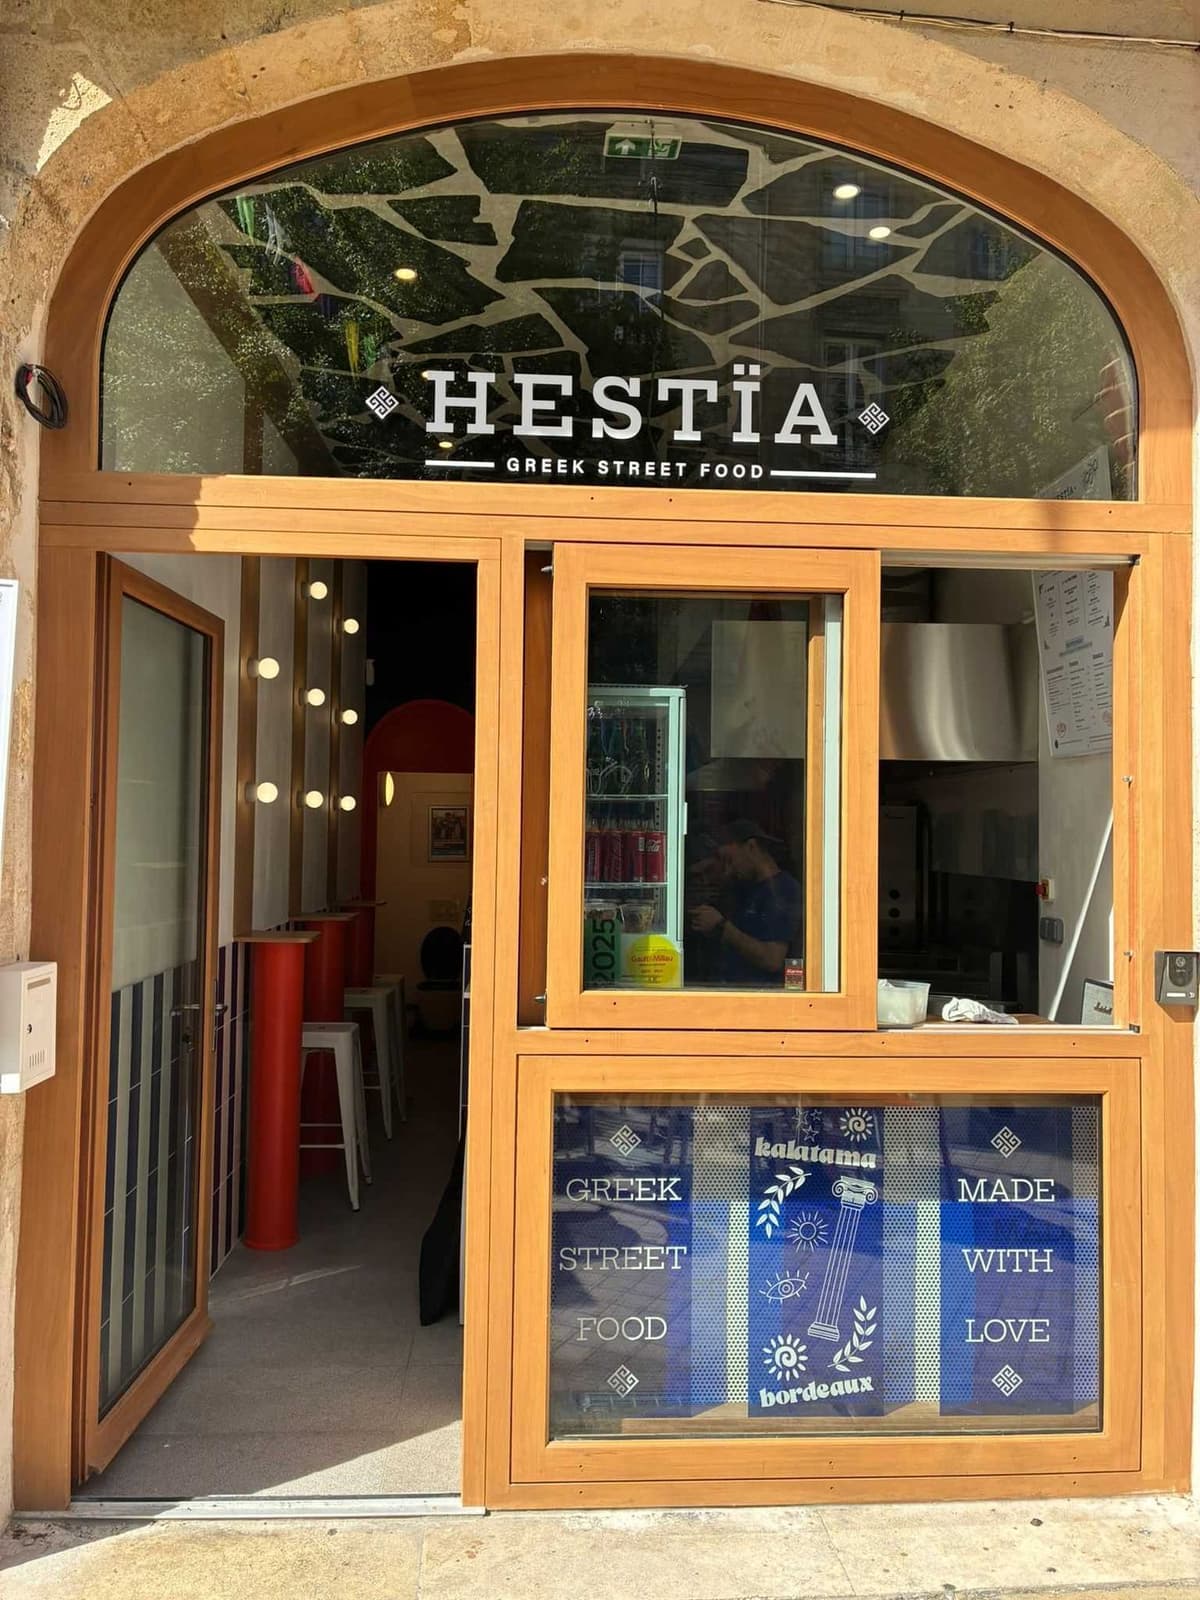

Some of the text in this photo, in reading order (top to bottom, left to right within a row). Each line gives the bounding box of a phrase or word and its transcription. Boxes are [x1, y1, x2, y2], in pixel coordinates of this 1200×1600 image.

[424, 364, 838, 446] HESTÏA
[506, 457, 764, 480] GREEK STREET FOOD
[754, 1136, 877, 1169] kalatama
[565, 1177, 682, 1202] GREEK
[957, 1178, 1056, 1203] MADE
[558, 1245, 688, 1272] STREET
[961, 1248, 1054, 1274] WITH
[576, 1315, 669, 1342] FOOD
[964, 1318, 1051, 1344] LOVE
[759, 1375, 875, 1409] bordeaux
